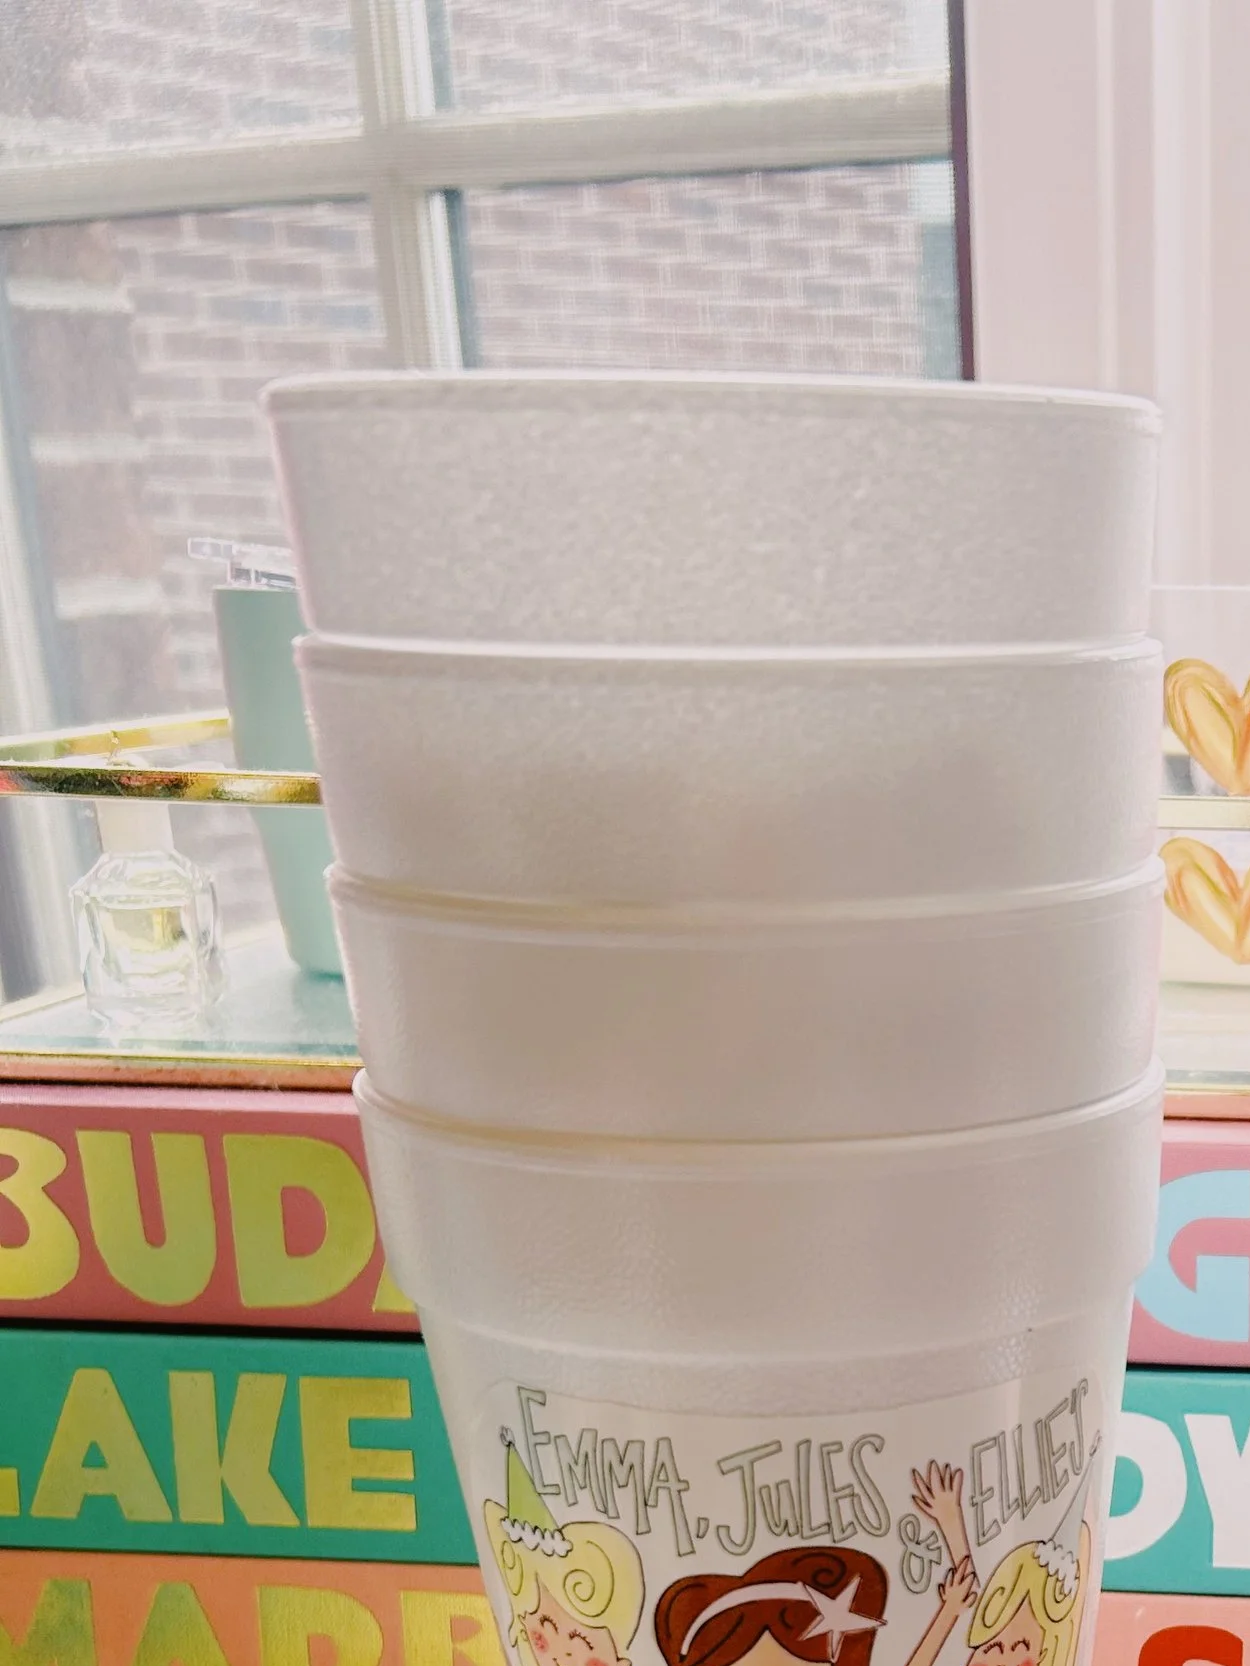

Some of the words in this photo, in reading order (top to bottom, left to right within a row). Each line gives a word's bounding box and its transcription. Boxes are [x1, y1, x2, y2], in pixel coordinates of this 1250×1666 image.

[0, 1127, 418, 1313] BUD
[0, 1367, 417, 1532] AKE
[517, 1386, 709, 1557] EMMA,
[899, 1514, 942, 1594] &
